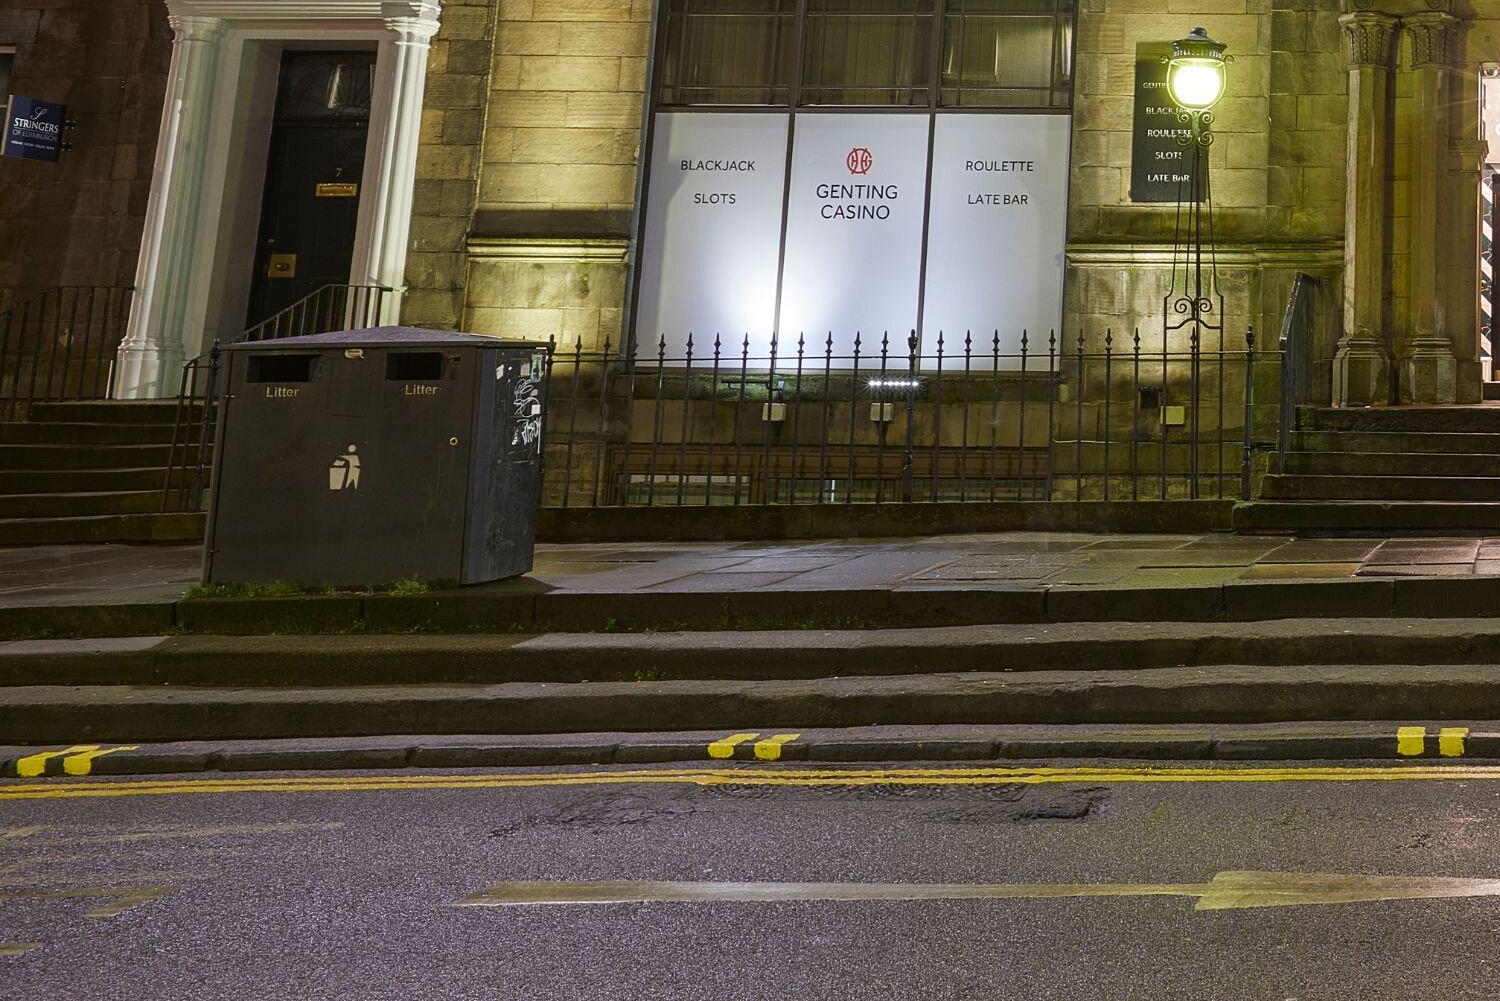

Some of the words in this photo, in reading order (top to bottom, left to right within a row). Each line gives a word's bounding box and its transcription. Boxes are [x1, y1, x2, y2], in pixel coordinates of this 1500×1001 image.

[13, 117, 60, 134] STRINGERS
[12, 128, 22, 136] OF
[22, 130, 58, 142] EDINBURGH
[335, 167, 343, 177] 7
[680, 160, 756, 172] BLACKJACK
[965, 160, 1035, 172] ROULETTE
[1147, 173, 1170, 182] LATE
[1172, 173, 1190, 182] BAR
[816, 184, 898, 200] GENTING
[694, 193, 736, 205] SLOTS
[967, 193, 1000, 205] LATE
[1003, 194, 1028, 205] BAR
[820, 204, 890, 220] CASINO
[266, 386, 300, 398] Litter
[405, 384, 438, 396] Litter
